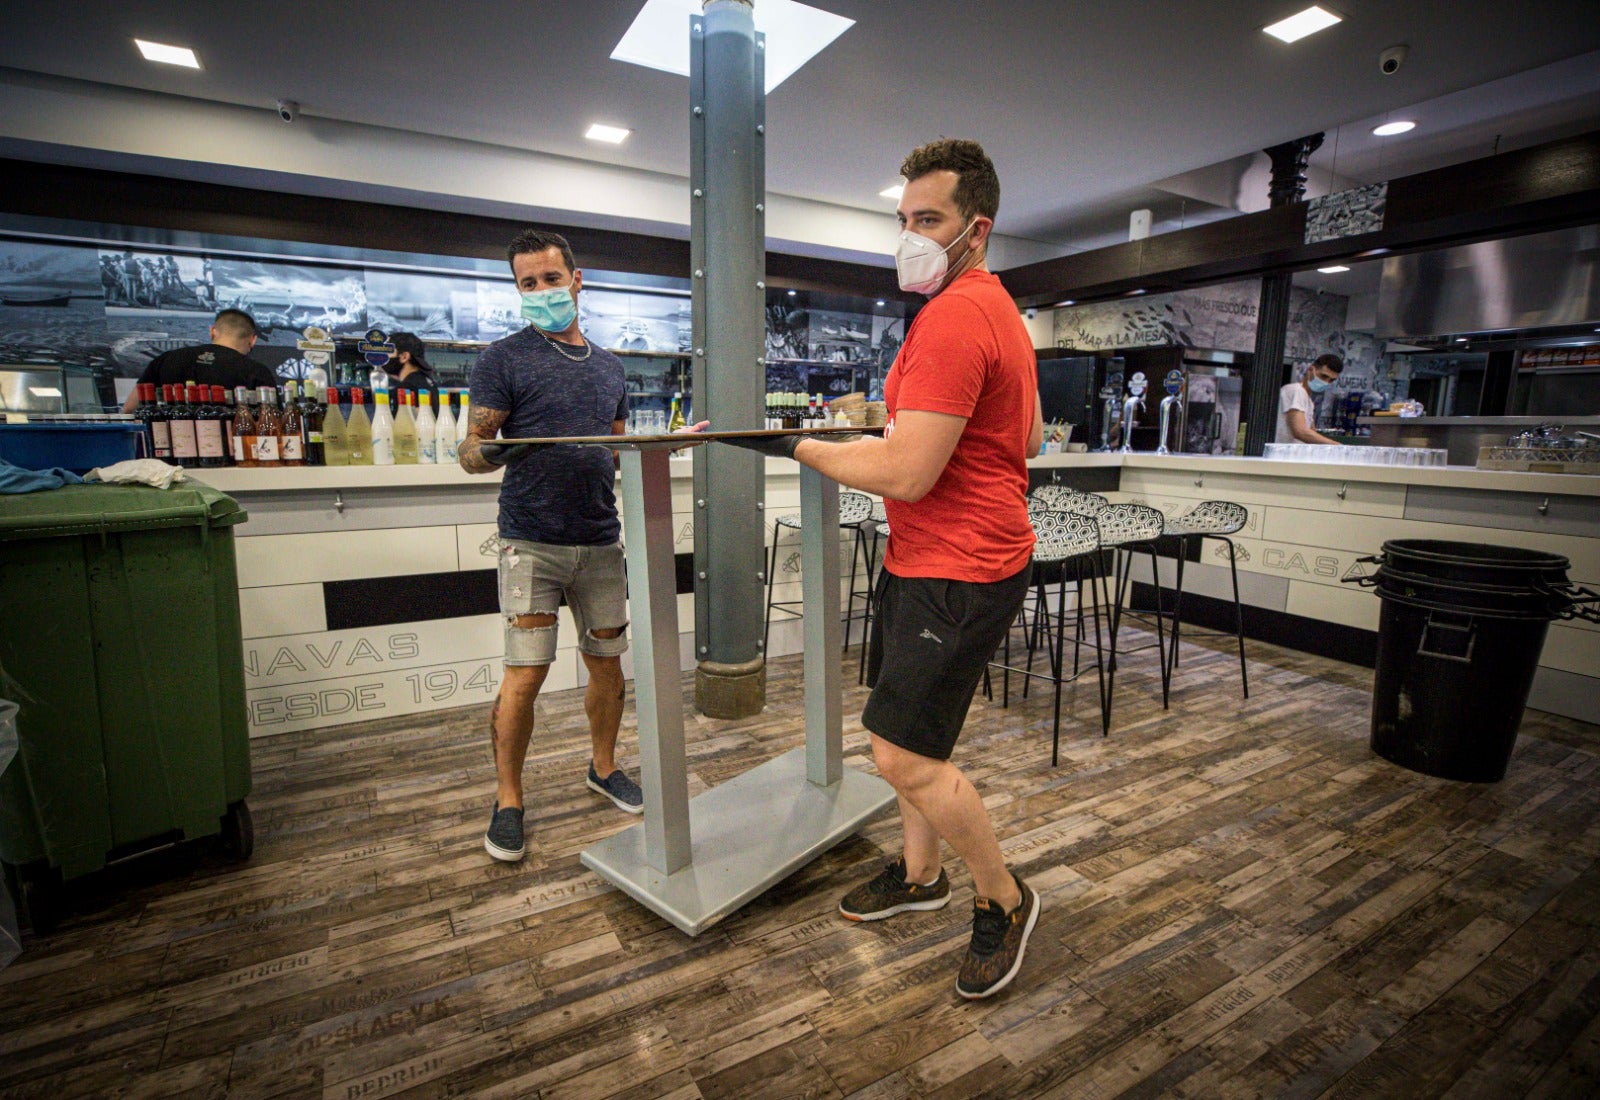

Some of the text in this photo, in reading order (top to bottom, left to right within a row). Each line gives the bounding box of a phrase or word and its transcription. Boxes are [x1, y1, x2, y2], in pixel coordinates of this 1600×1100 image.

[1134, 329, 1167, 344] MESA
[1262, 548, 1368, 579] CASA
[247, 663, 498, 727] ESDE 194
